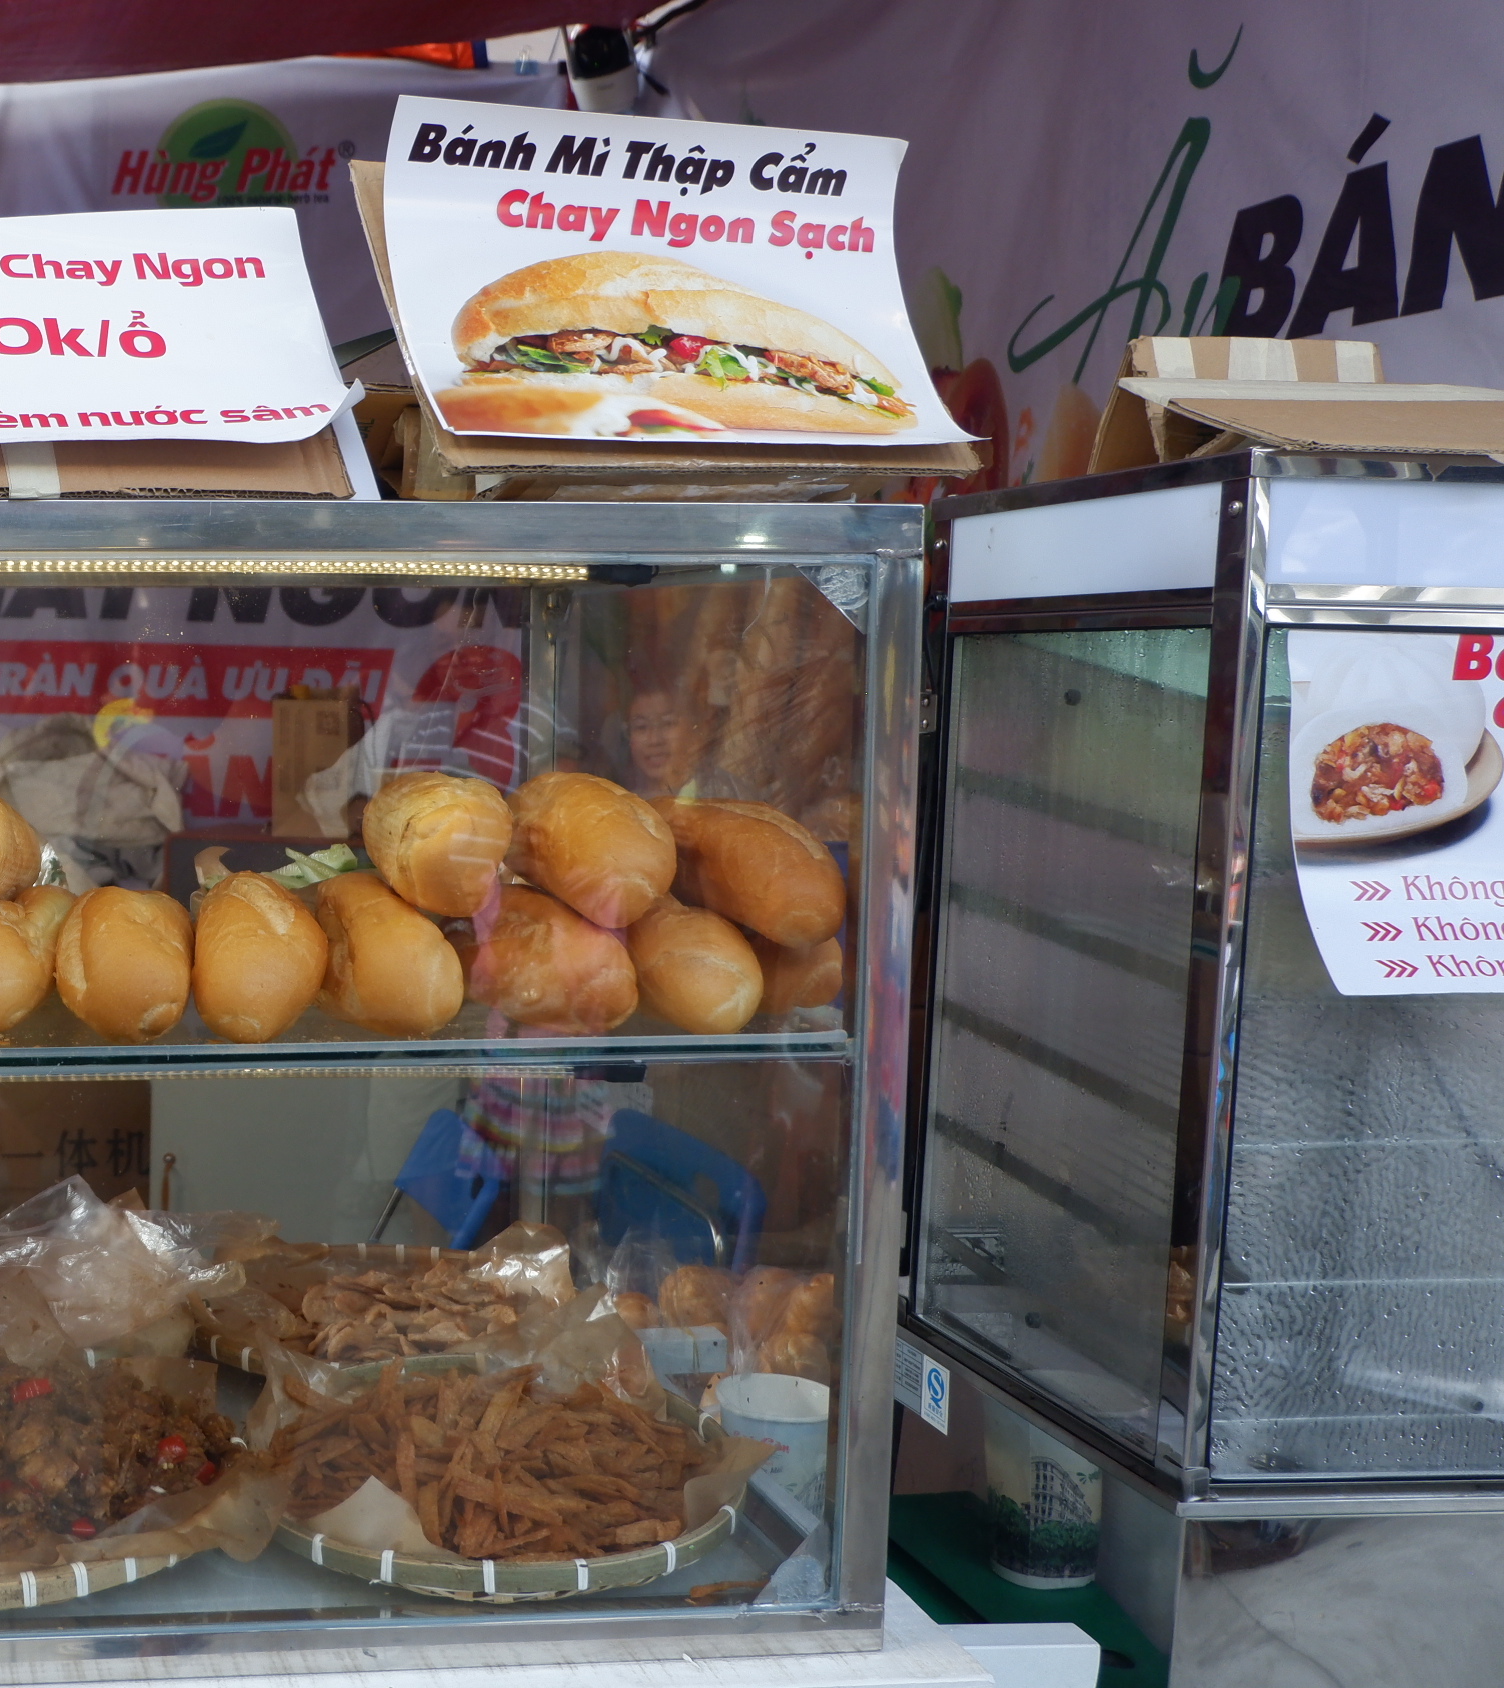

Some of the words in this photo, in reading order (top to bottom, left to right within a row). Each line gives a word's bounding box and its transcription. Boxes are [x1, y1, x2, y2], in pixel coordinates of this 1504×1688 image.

[111, 148, 226, 203] Hùng
[237, 146, 336, 193] Phát
[407, 123, 536, 171] Bánh
[545, 135, 612, 177] Mì
[622, 140, 735, 196] Thập
[750, 142, 848, 196] Cẩm
[497, 189, 619, 242] Chay
[630, 199, 755, 248] Ngon
[768, 210, 875, 259] Sạch
[0, 254, 123, 287] Chay
[133, 252, 266, 287] Ngon
[78, 406, 208, 428] nước
[220, 404, 331, 424] sâm
[107, 654, 210, 700] QUÀ
[222, 659, 291, 702] ƯU
[1452, 633, 1504, 681] B
[1411, 915, 1504, 942] Khôn
